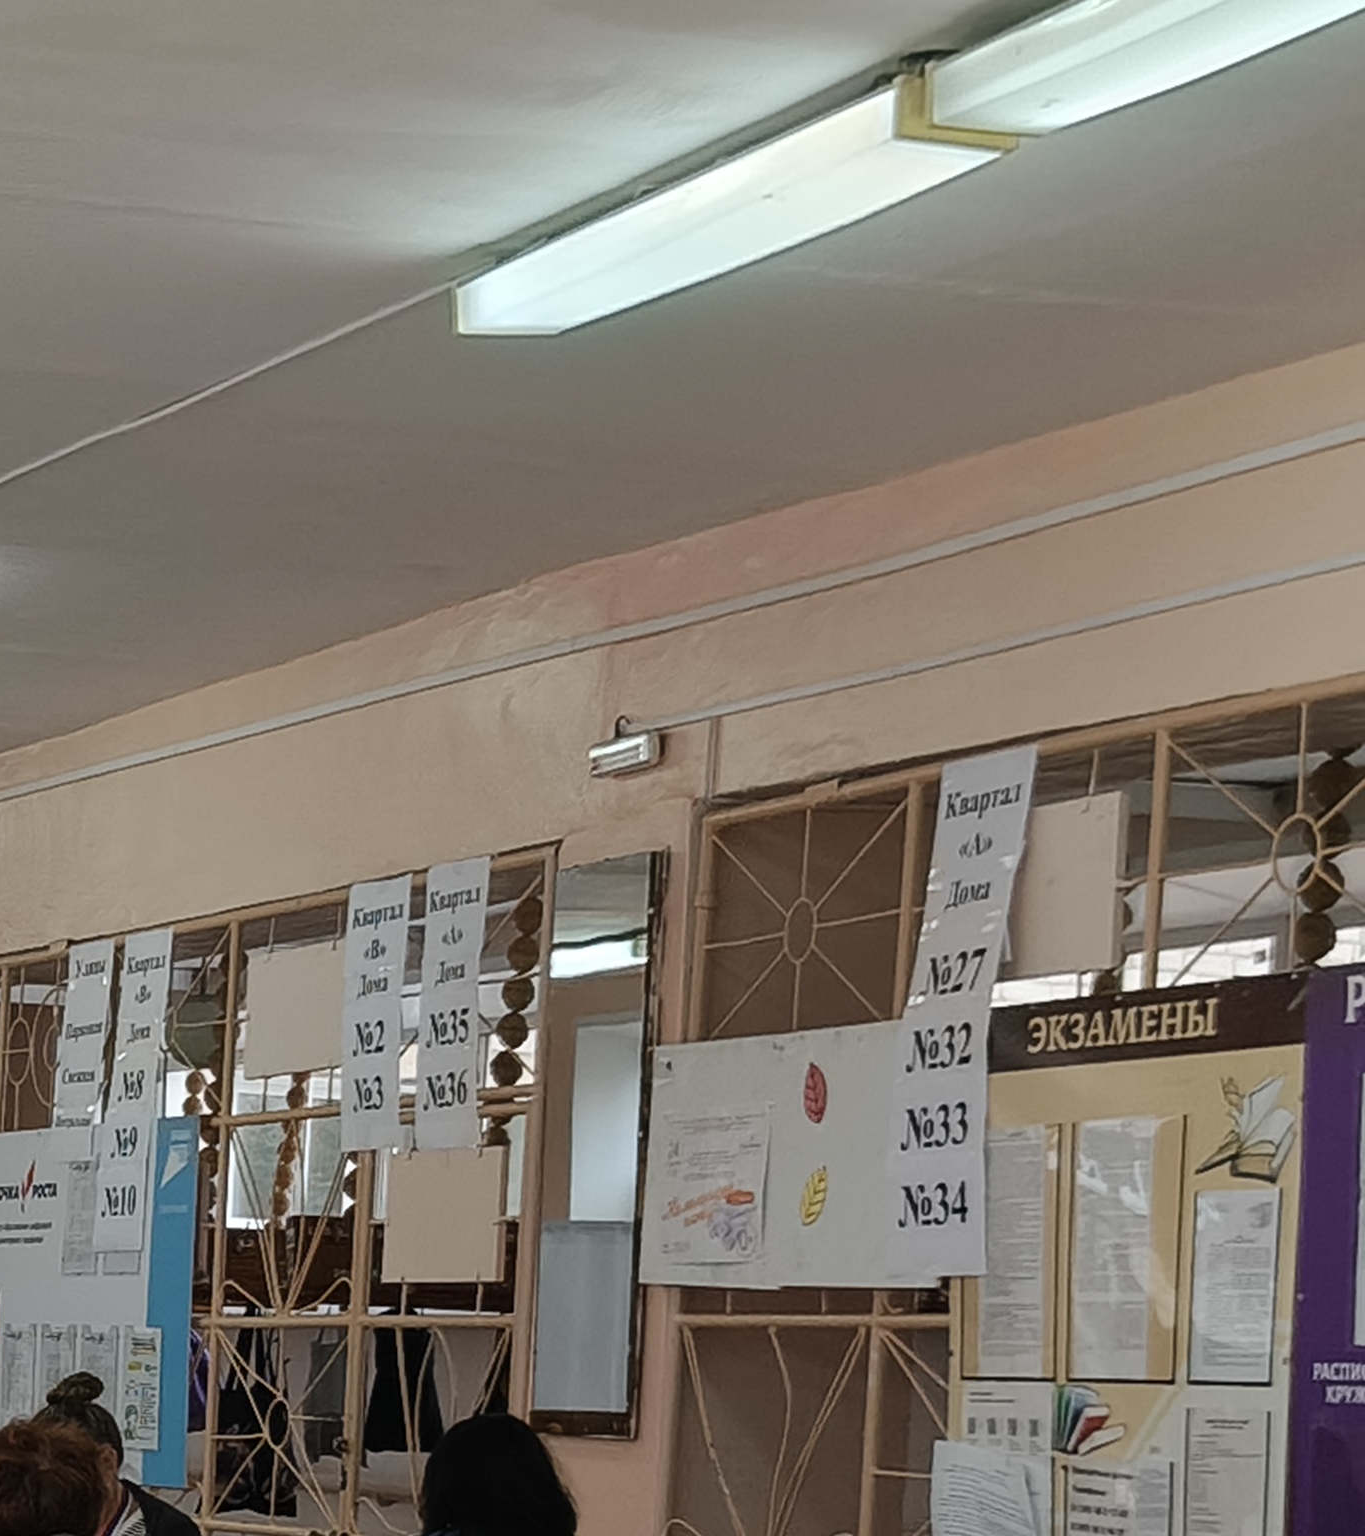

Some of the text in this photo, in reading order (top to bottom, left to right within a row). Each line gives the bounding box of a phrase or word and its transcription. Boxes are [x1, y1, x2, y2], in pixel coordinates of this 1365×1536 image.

[944, 782, 1022, 820] Квартал
[429, 887, 481, 914] Квартал
[944, 880, 991, 912] Дома
[352, 903, 405, 930] Квартал
[126, 955, 167, 977] Квартал
[434, 960, 466, 987] Дома
[918, 948, 987, 996] №27
[356, 974, 388, 999] Дома
[352, 1019, 385, 1057] №2
[426, 1007, 470, 1048] №35
[1026, 997, 1219, 1054] ЭКЗАМЕНЫ
[905, 1022, 972, 1073] №32
[117, 1069, 145, 1102] №8
[353, 1075, 384, 1113] №3
[423, 1069, 468, 1111] №36
[110, 1126, 138, 1158] №9
[900, 1101, 968, 1151] №33
[101, 1184, 136, 1218] №10
[898, 1180, 968, 1228] №34
